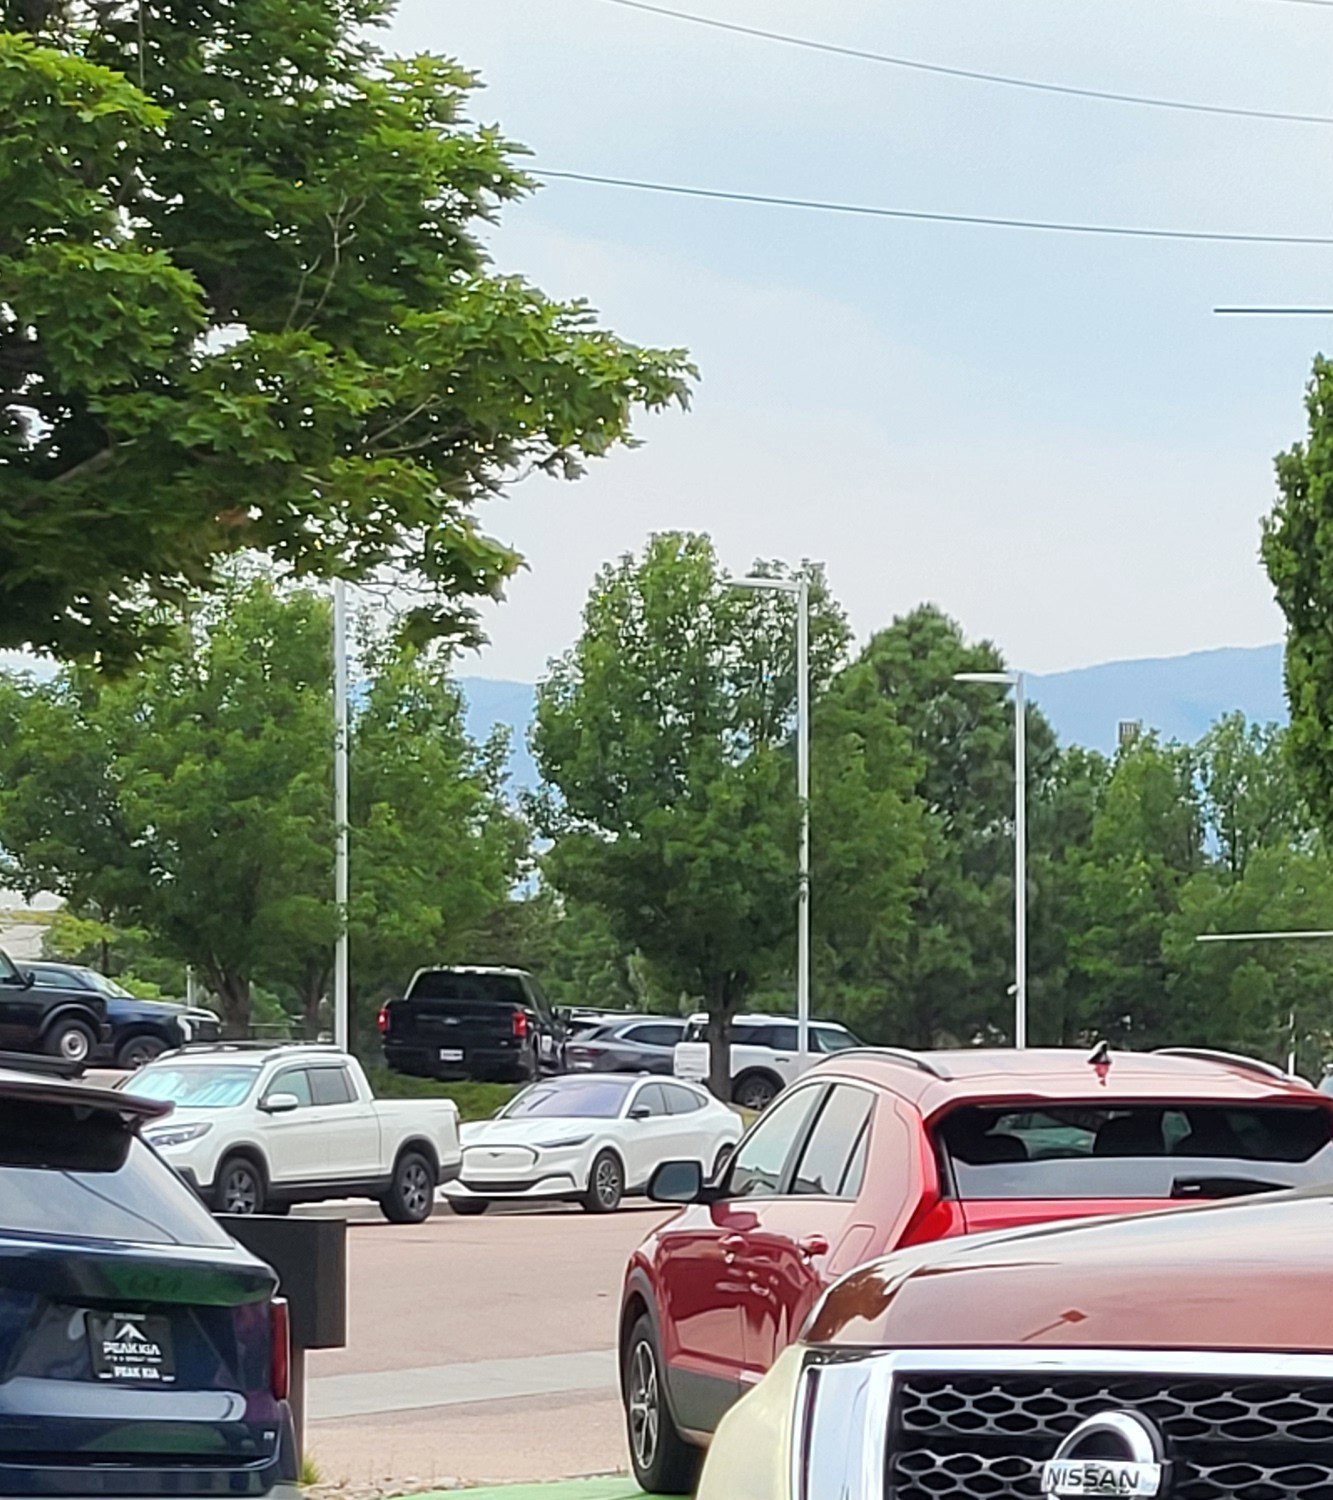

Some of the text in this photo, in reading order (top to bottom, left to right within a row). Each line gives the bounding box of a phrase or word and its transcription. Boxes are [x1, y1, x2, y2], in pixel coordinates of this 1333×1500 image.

[114, 1365, 160, 1379] PEAK KIA
[1047, 1467, 1140, 1489] NISSAN
